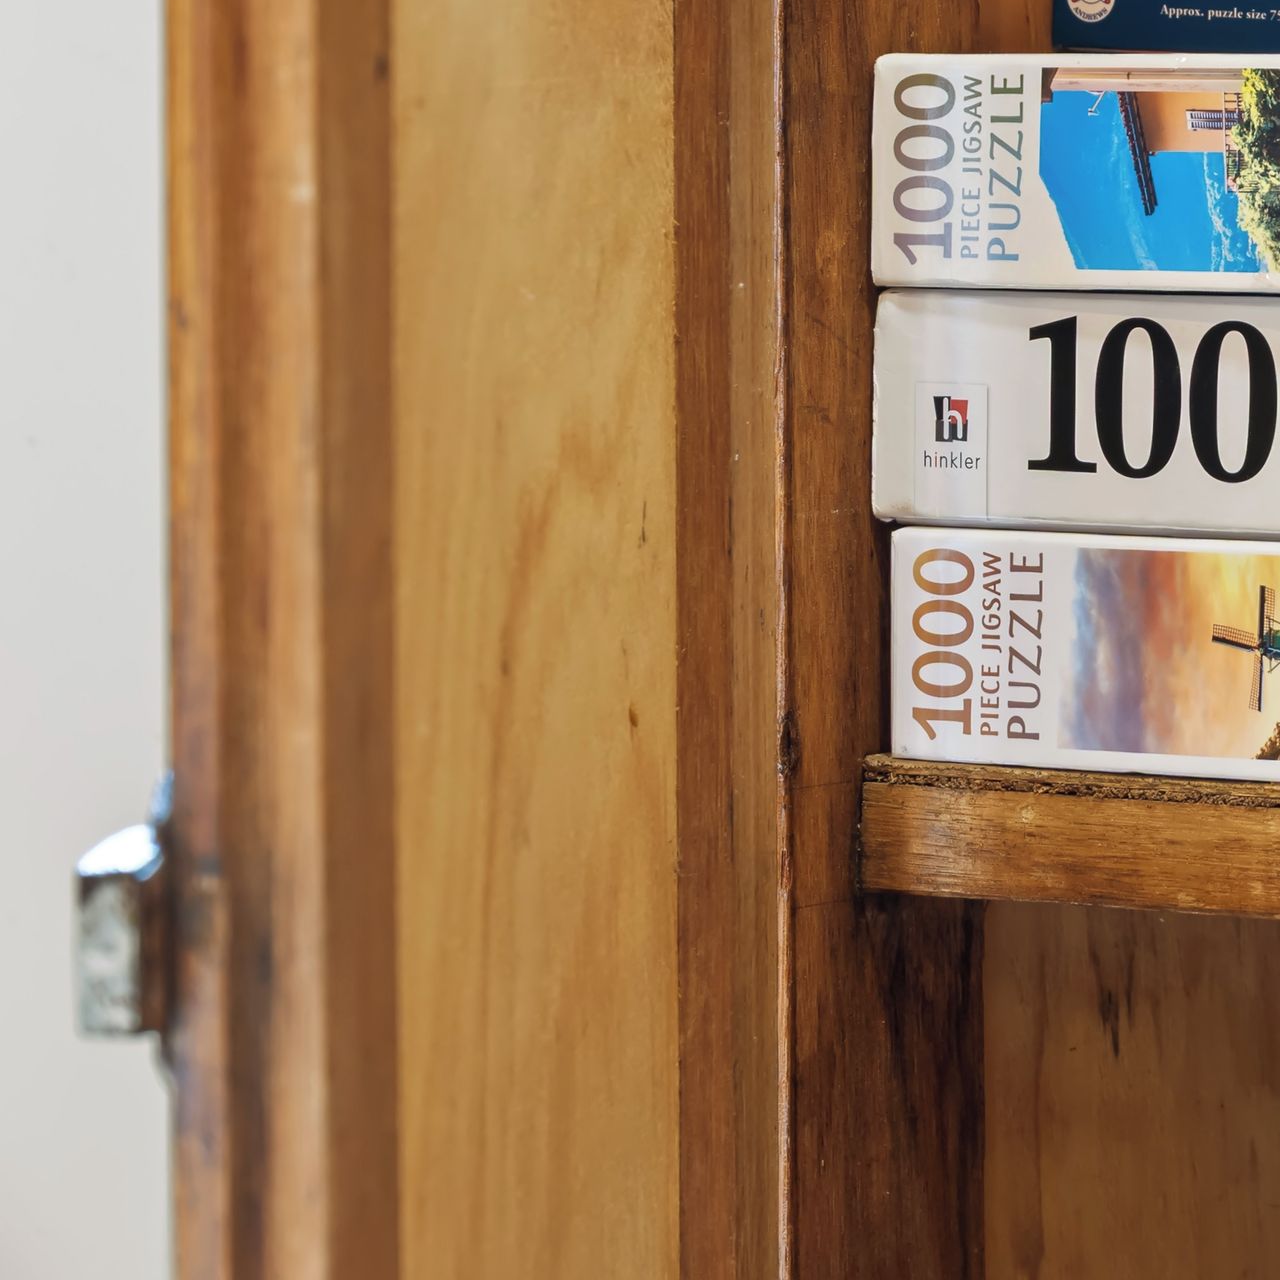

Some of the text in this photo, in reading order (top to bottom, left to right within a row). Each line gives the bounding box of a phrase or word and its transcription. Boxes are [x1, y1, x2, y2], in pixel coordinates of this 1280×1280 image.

[1160, 4, 1205, 20] Approx.
[1207, 6, 1244, 21] puzzle
[1246, 8, 1267, 21] size
[893, 73, 956, 266] 1000
[960, 75, 983, 259] PIECE JIGSAW
[986, 73, 1025, 262] PUZZLE
[922, 450, 981, 470] hinkler
[911, 548, 976, 741] 1000
[980, 551, 1002, 736] PIECE JIGSAW
[1006, 551, 1044, 741] PUZZLE
